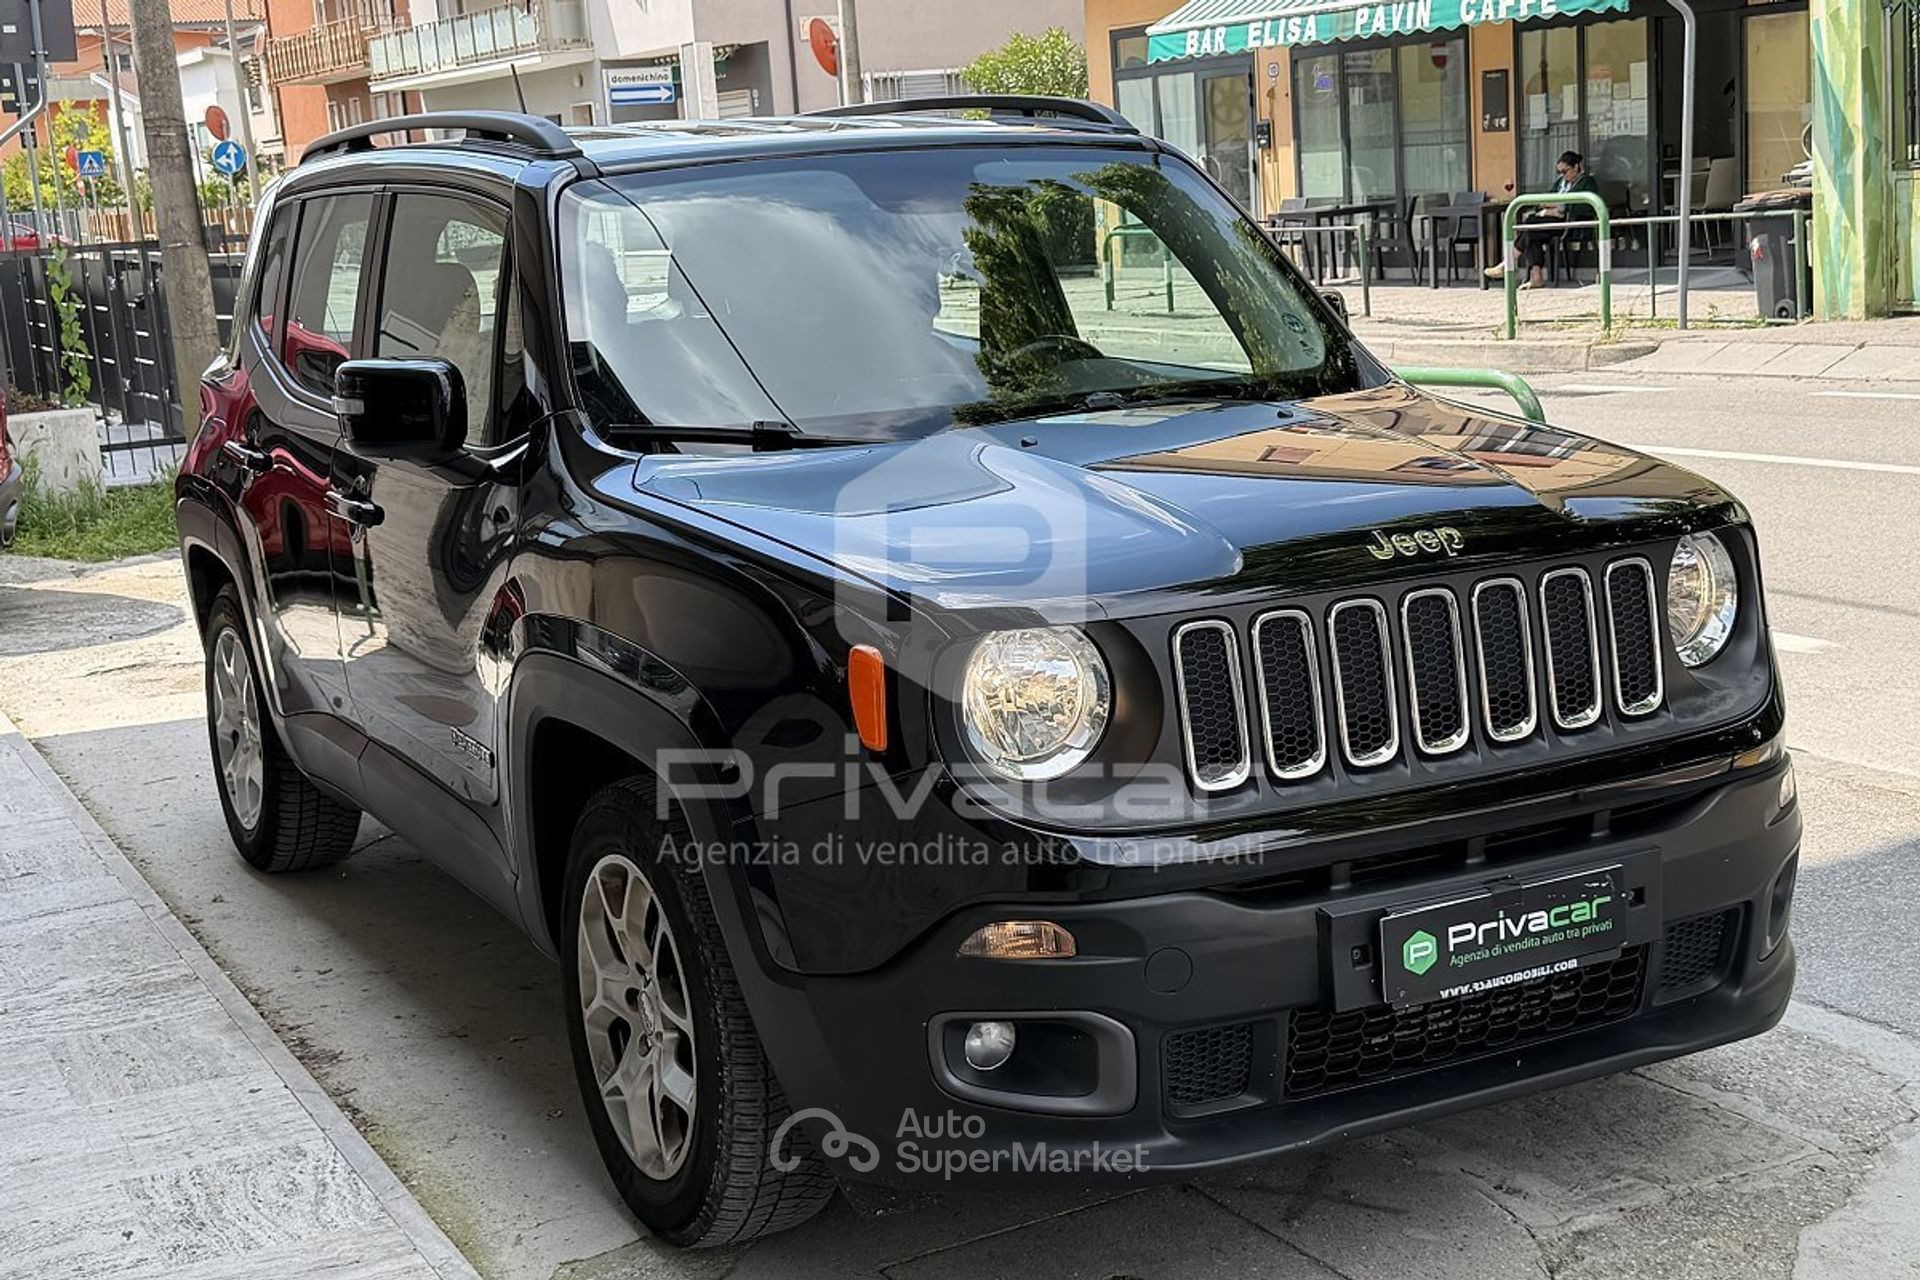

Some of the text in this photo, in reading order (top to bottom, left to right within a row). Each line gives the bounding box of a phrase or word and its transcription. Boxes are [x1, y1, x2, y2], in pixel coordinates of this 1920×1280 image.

[1186, 26, 1226, 55] BAR
[1247, 14, 1317, 48] ELISA
[1355, 0, 1431, 35] PAVIN
[611, 72, 670, 83] domenichino
[1366, 526, 1464, 560] Jeep
[1447, 896, 1612, 951] Privacar
[1450, 918, 1614, 967] Agenzia di vendita auto tra privati
